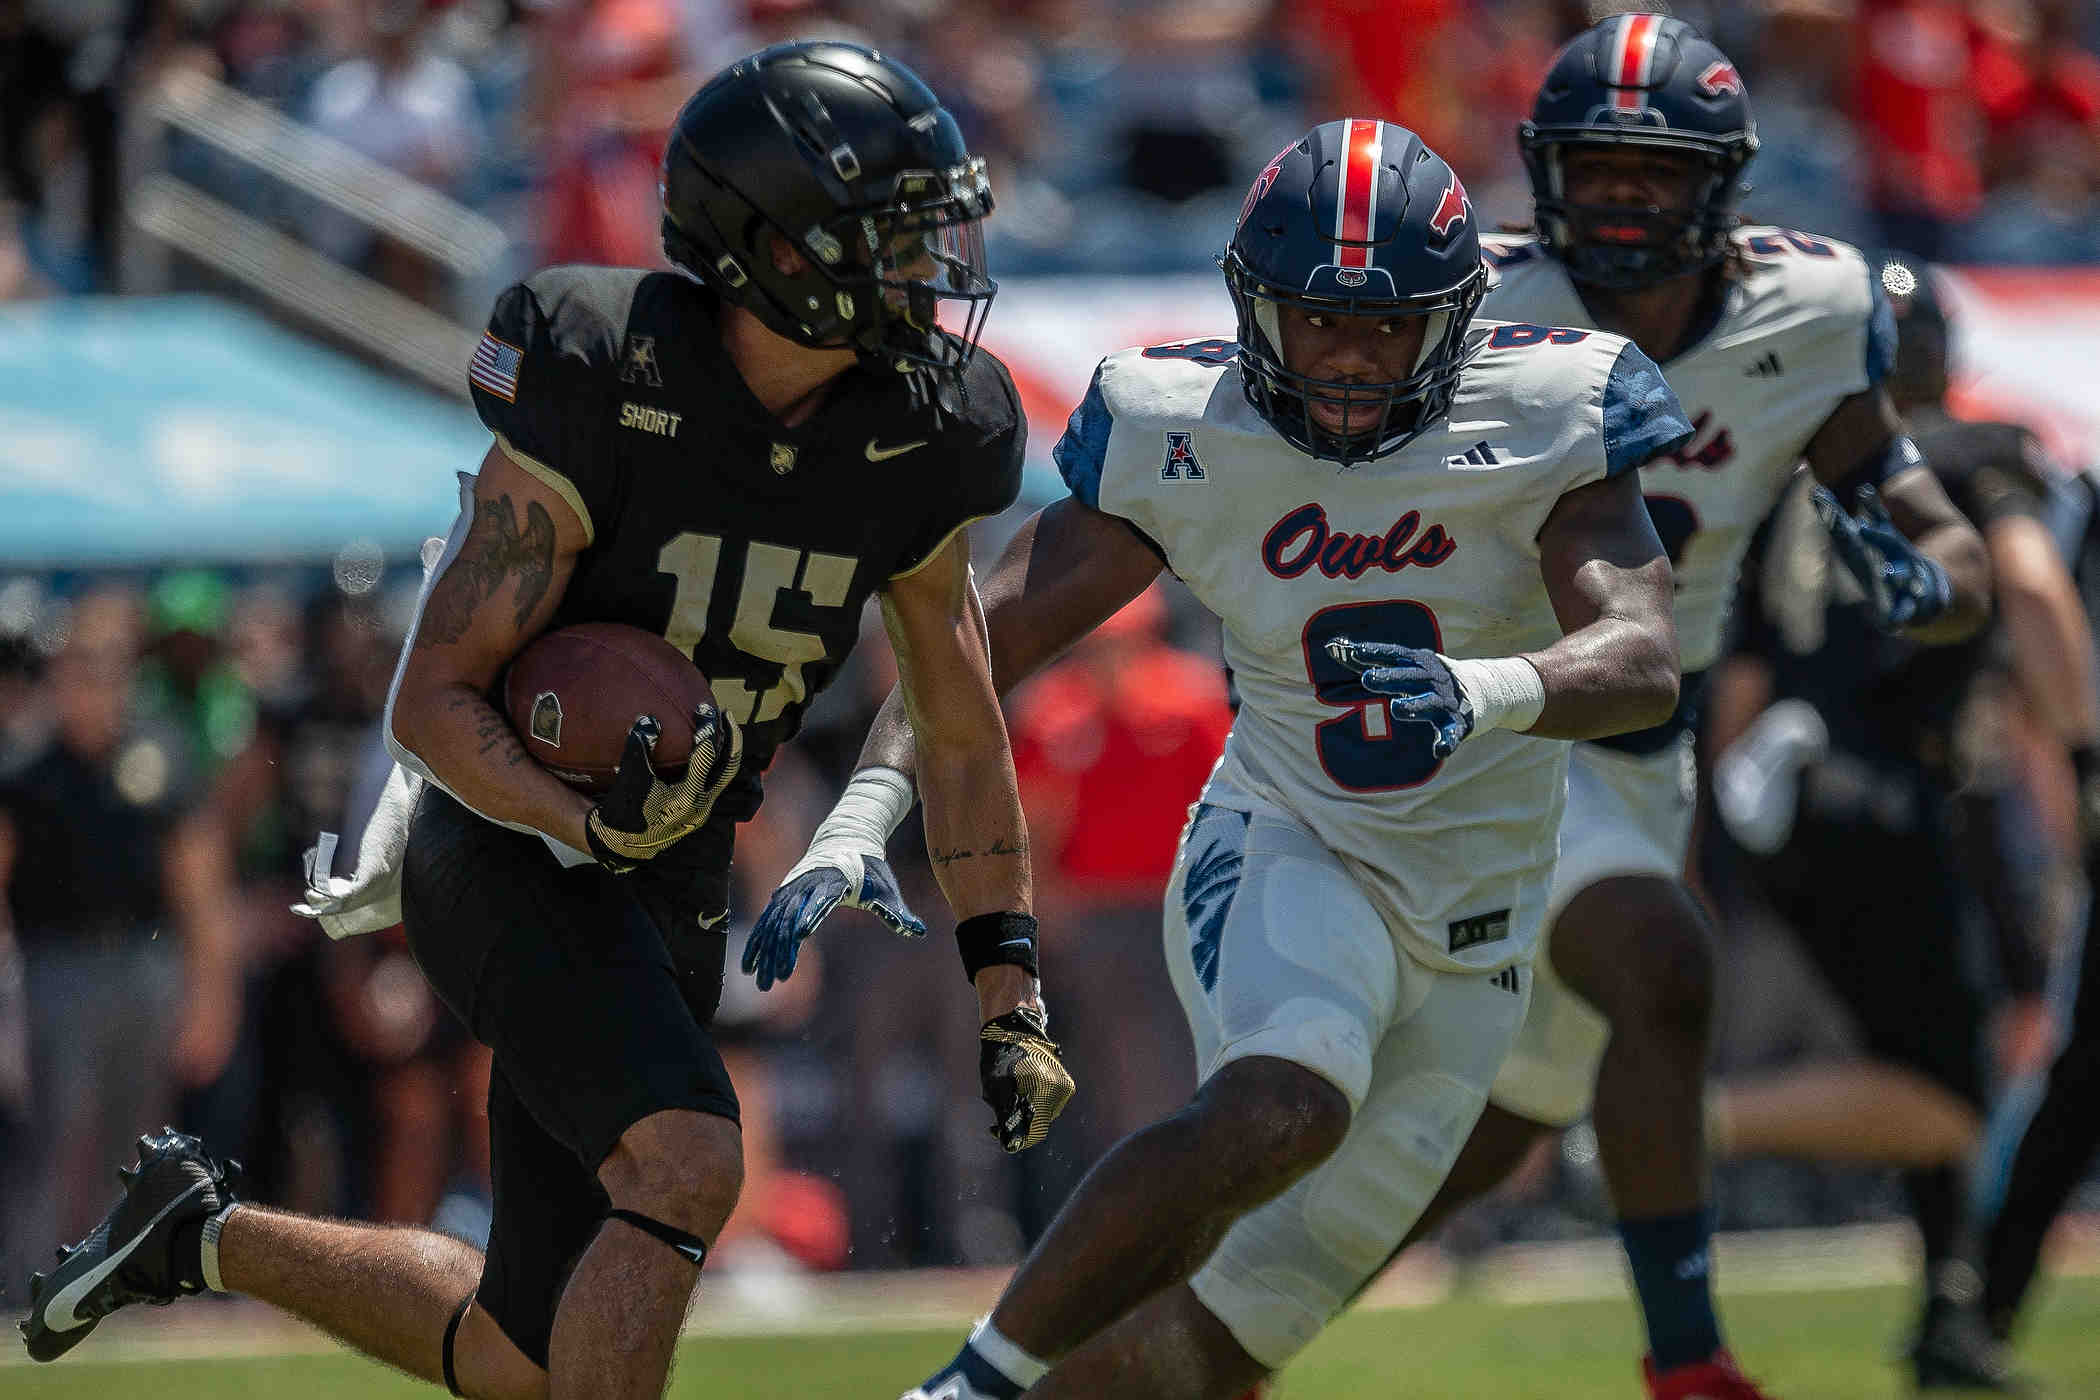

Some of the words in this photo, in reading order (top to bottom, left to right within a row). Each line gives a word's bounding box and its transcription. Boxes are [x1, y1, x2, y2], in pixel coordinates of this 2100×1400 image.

[621, 336, 664, 387] A
[619, 402, 682, 437] SHORT
[1162, 431, 1205, 480] A
[1261, 502, 1458, 580] Owls
[657, 531, 859, 725] 15
[1301, 599, 1446, 794] 9
